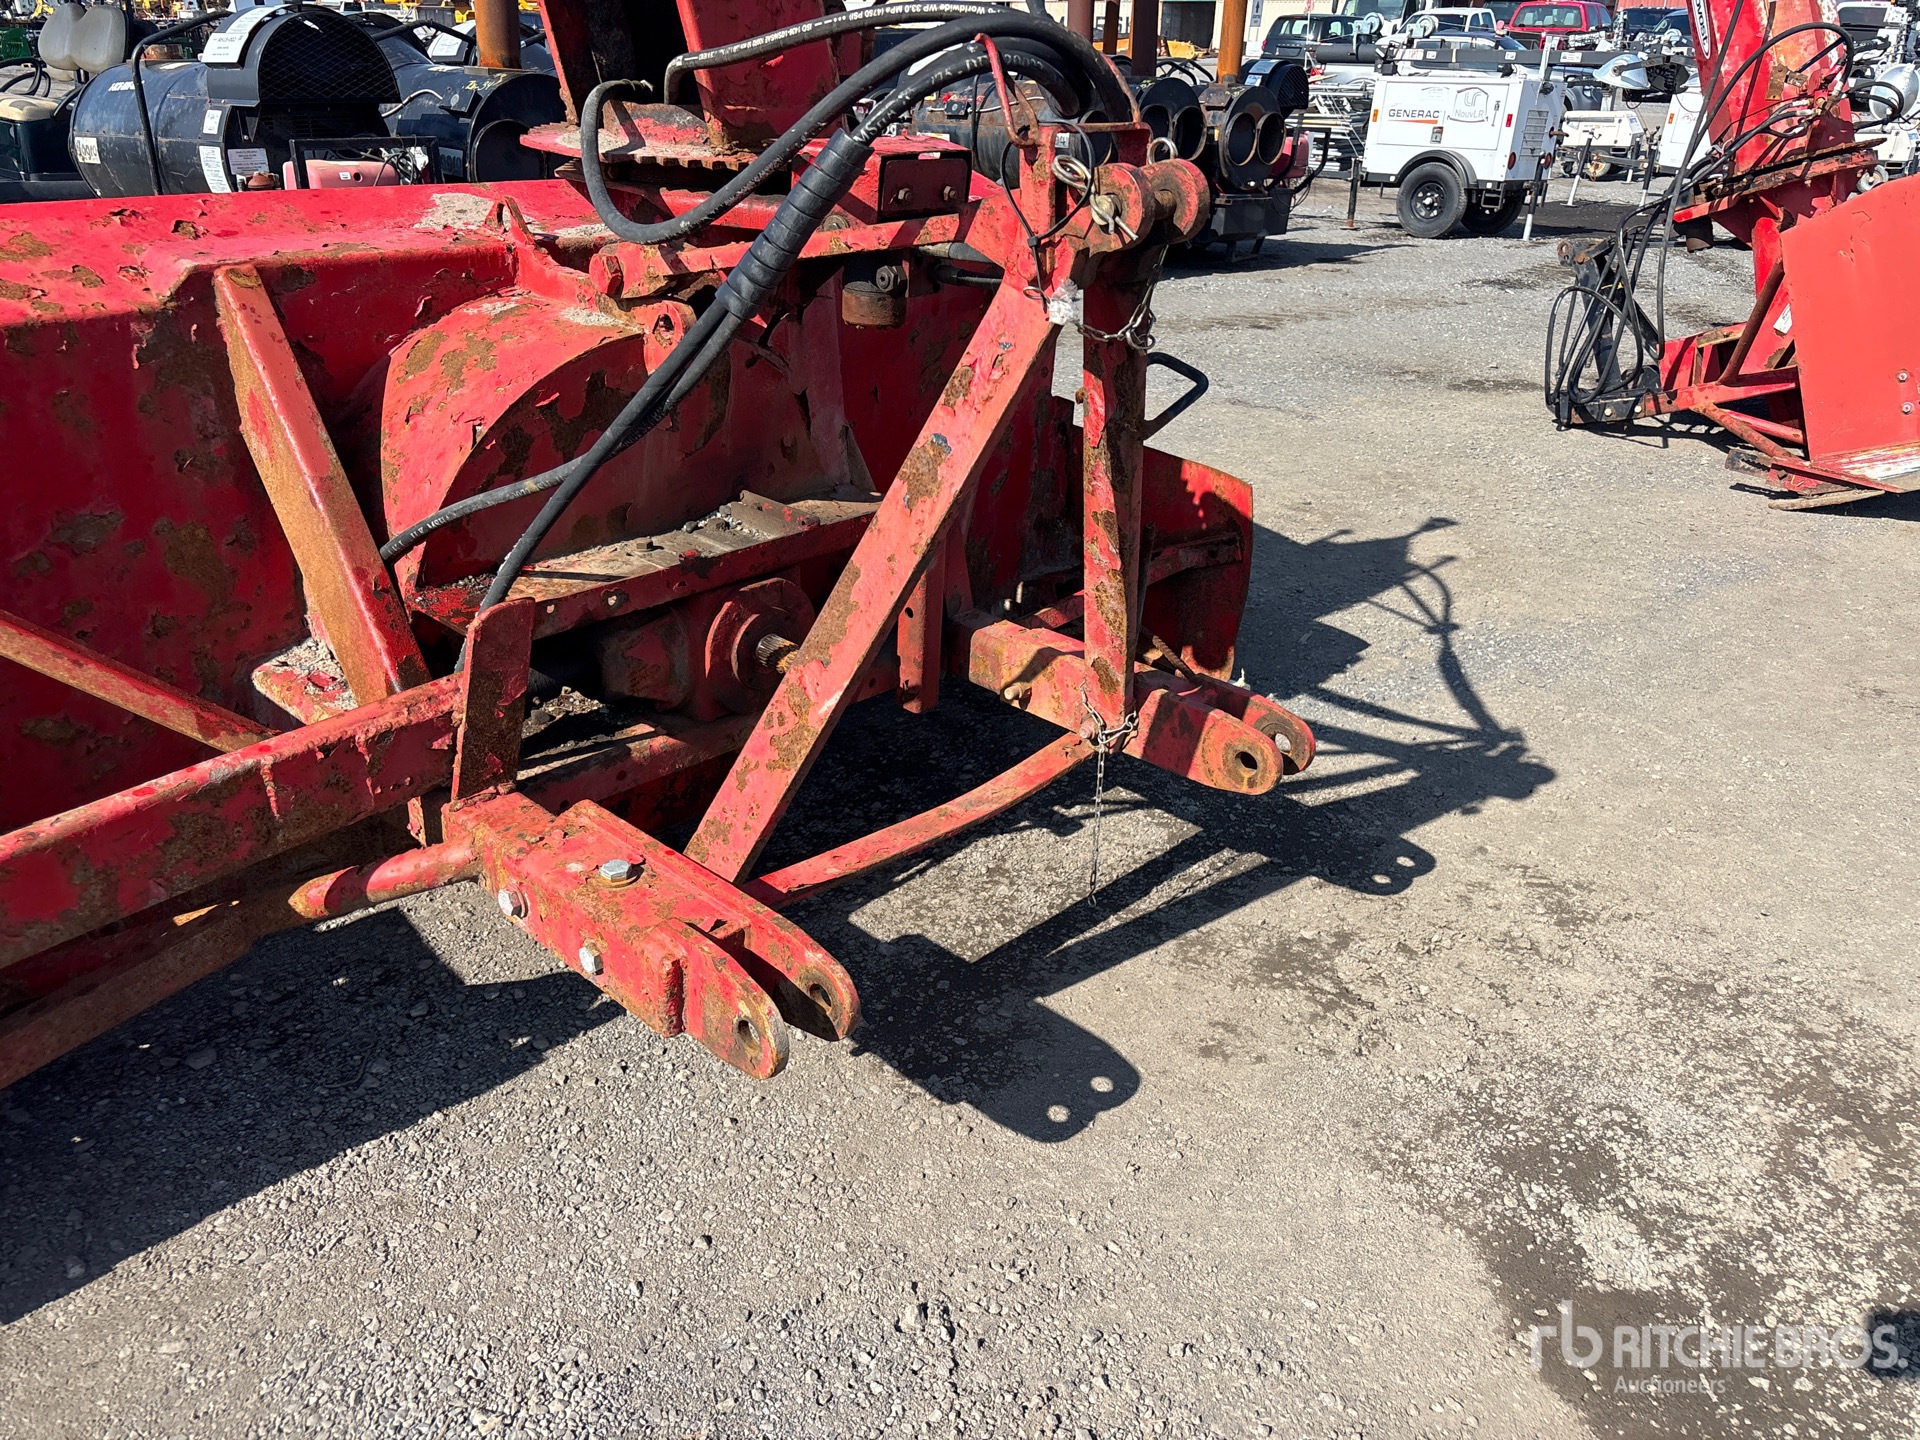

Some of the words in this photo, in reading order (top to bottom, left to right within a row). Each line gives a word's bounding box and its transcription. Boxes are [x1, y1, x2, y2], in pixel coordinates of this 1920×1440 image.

[885, 5, 903, 14] MPa
[904, 4, 922, 13] 33.0
[923, 4, 938, 13] WP
[939, 3, 986, 15] Worldwide
[848, 10, 864, 21] PSI)
[1388, 108, 1440, 119] GENERAC
